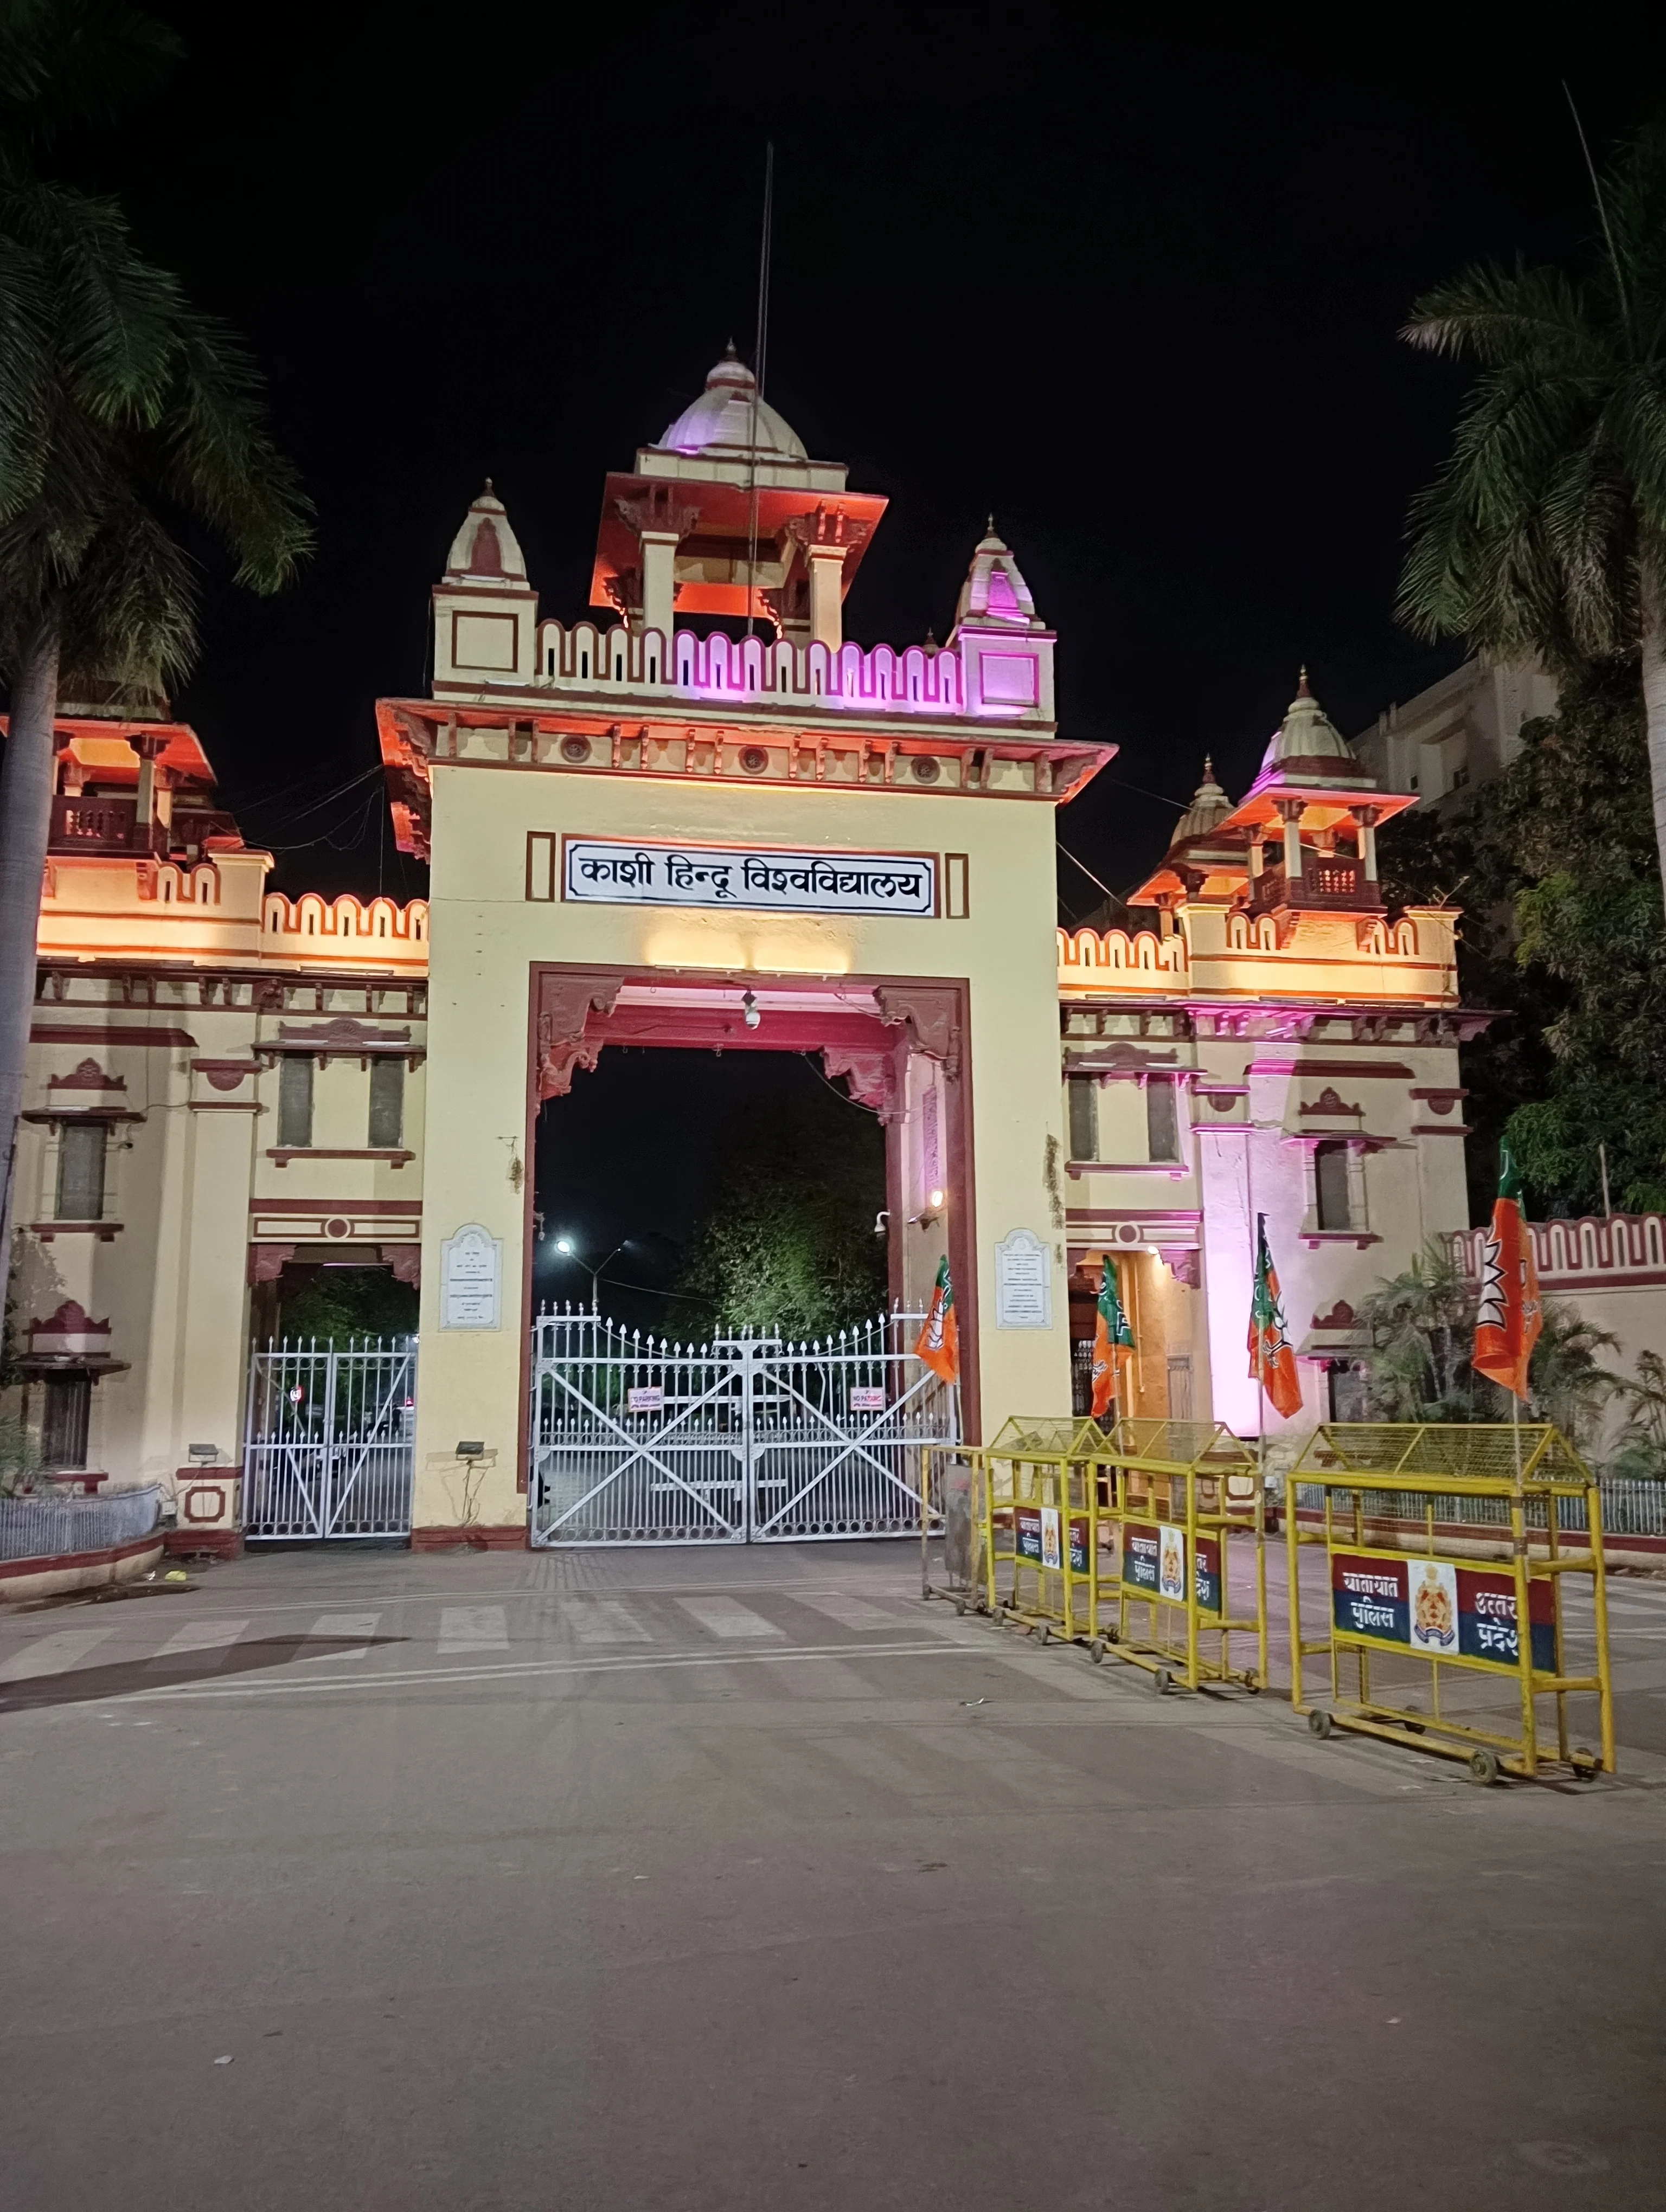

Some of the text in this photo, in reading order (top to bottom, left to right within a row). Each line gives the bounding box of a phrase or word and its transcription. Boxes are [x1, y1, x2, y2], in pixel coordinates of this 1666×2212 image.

[578, 852, 924, 898] काशी हिन्दू विश्वविद्यालय
[1342, 1572, 1399, 1598] यातायात
[1350, 1596, 1394, 1629] पुलिस
